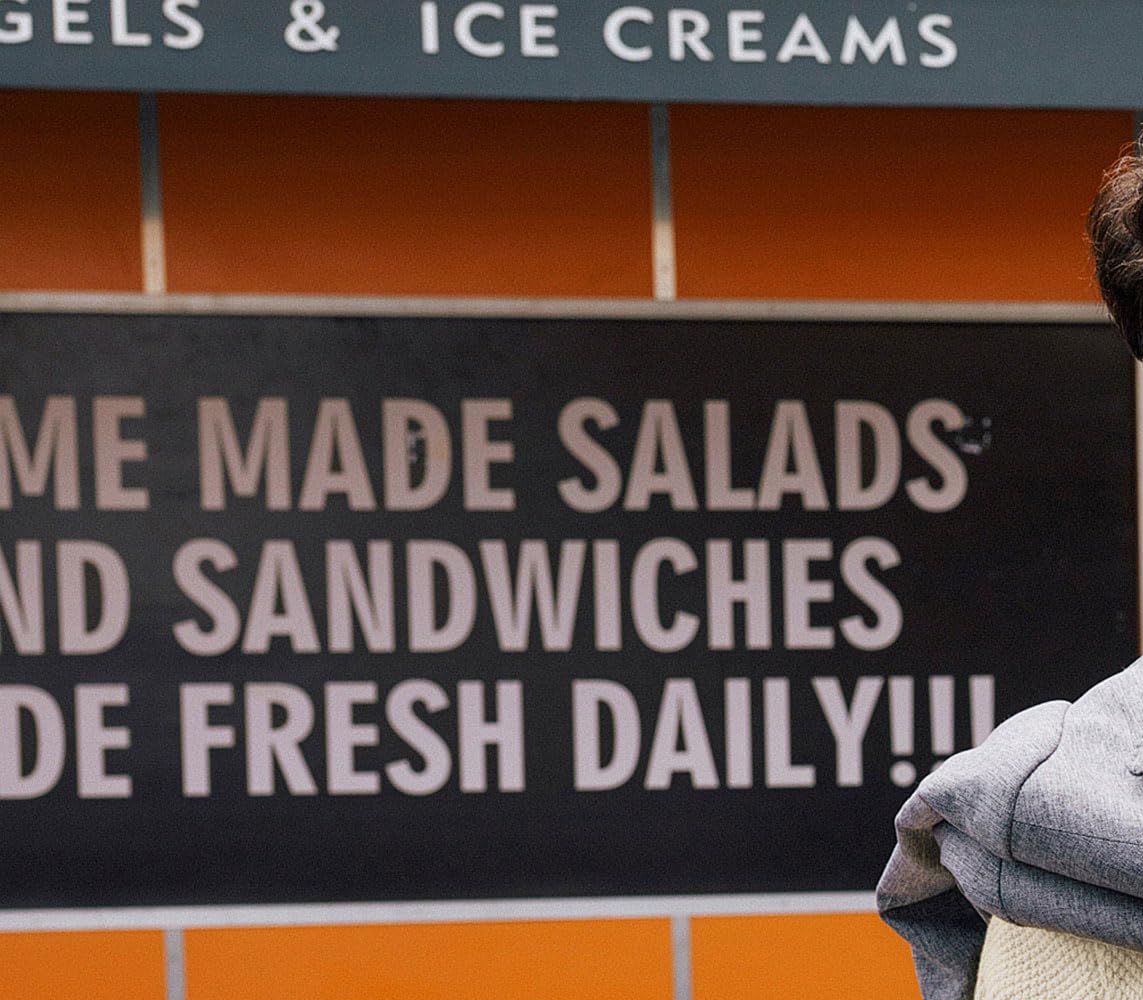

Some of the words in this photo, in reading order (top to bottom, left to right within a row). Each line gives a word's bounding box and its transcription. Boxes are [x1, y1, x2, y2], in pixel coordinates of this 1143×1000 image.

[283, 0, 341, 53] &
[421, 1, 560, 58] ICE
[603, 7, 959, 69] CREAMS
[0, 395, 151, 511] ME
[198, 397, 517, 511] MADE
[557, 397, 970, 513] SALADS
[172, 537, 904, 656] SANDWICHES
[0, 683, 133, 800] DE
[180, 679, 526, 797] FRESH
